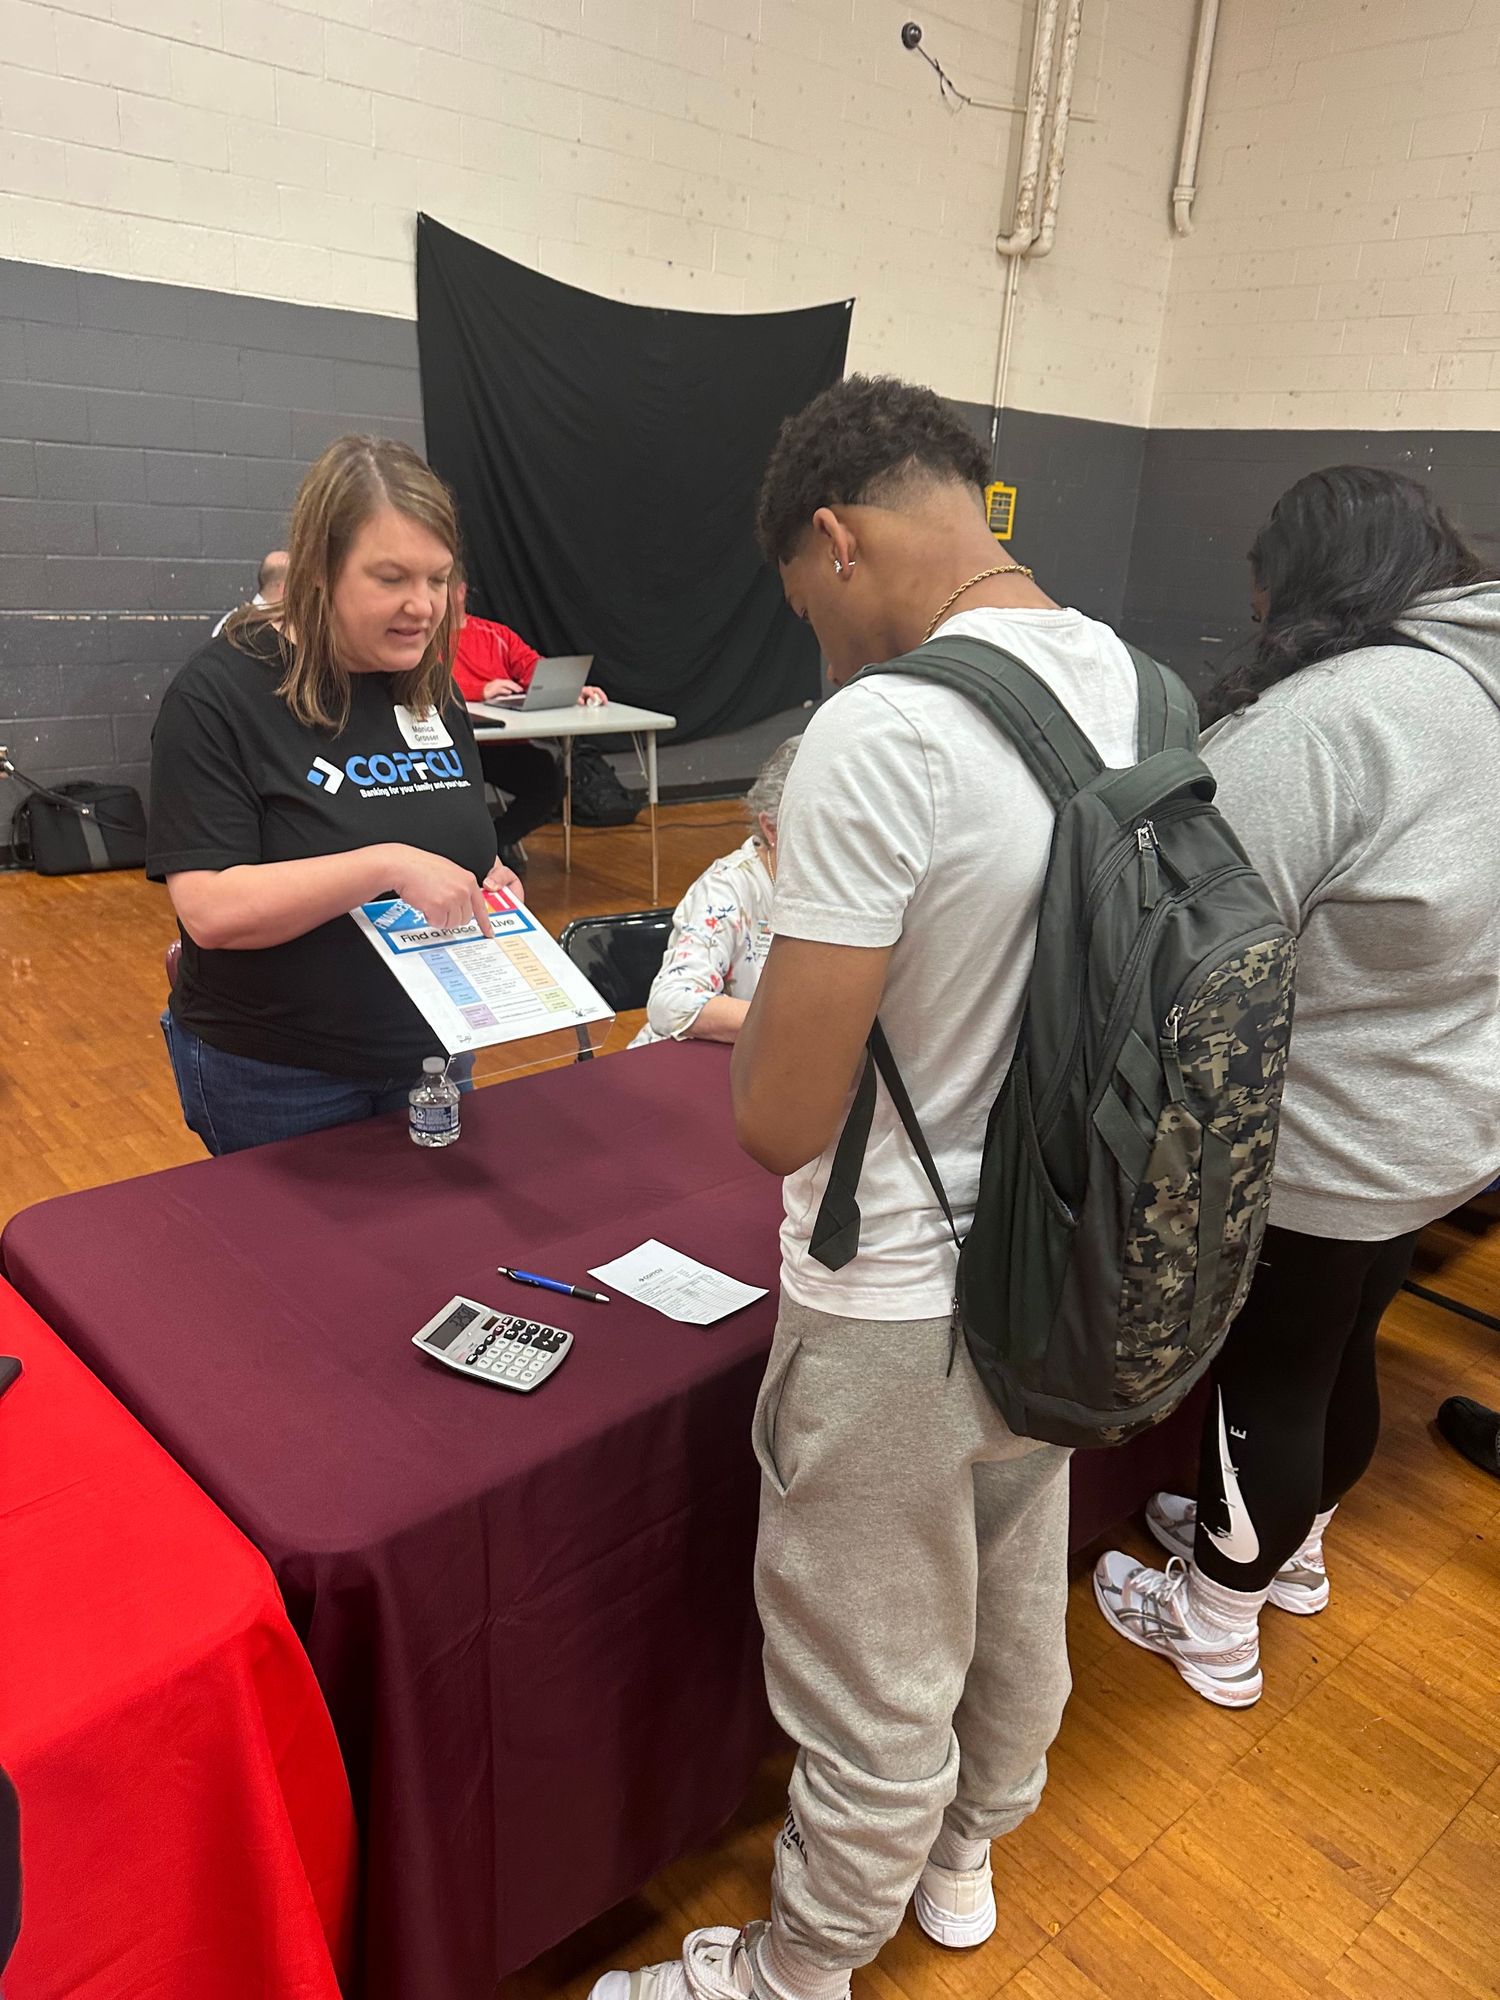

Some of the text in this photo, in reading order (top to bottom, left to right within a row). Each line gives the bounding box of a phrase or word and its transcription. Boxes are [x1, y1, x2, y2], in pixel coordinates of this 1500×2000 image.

[411, 725, 435, 733] Monica
[345, 749, 464, 786] COPFCU
[360, 787, 391, 799] Banking
[388, 785, 399, 795] for
[399, 784, 415, 796] your
[413, 781, 434, 792] family
[400, 919, 515, 943] Find a Place Live
